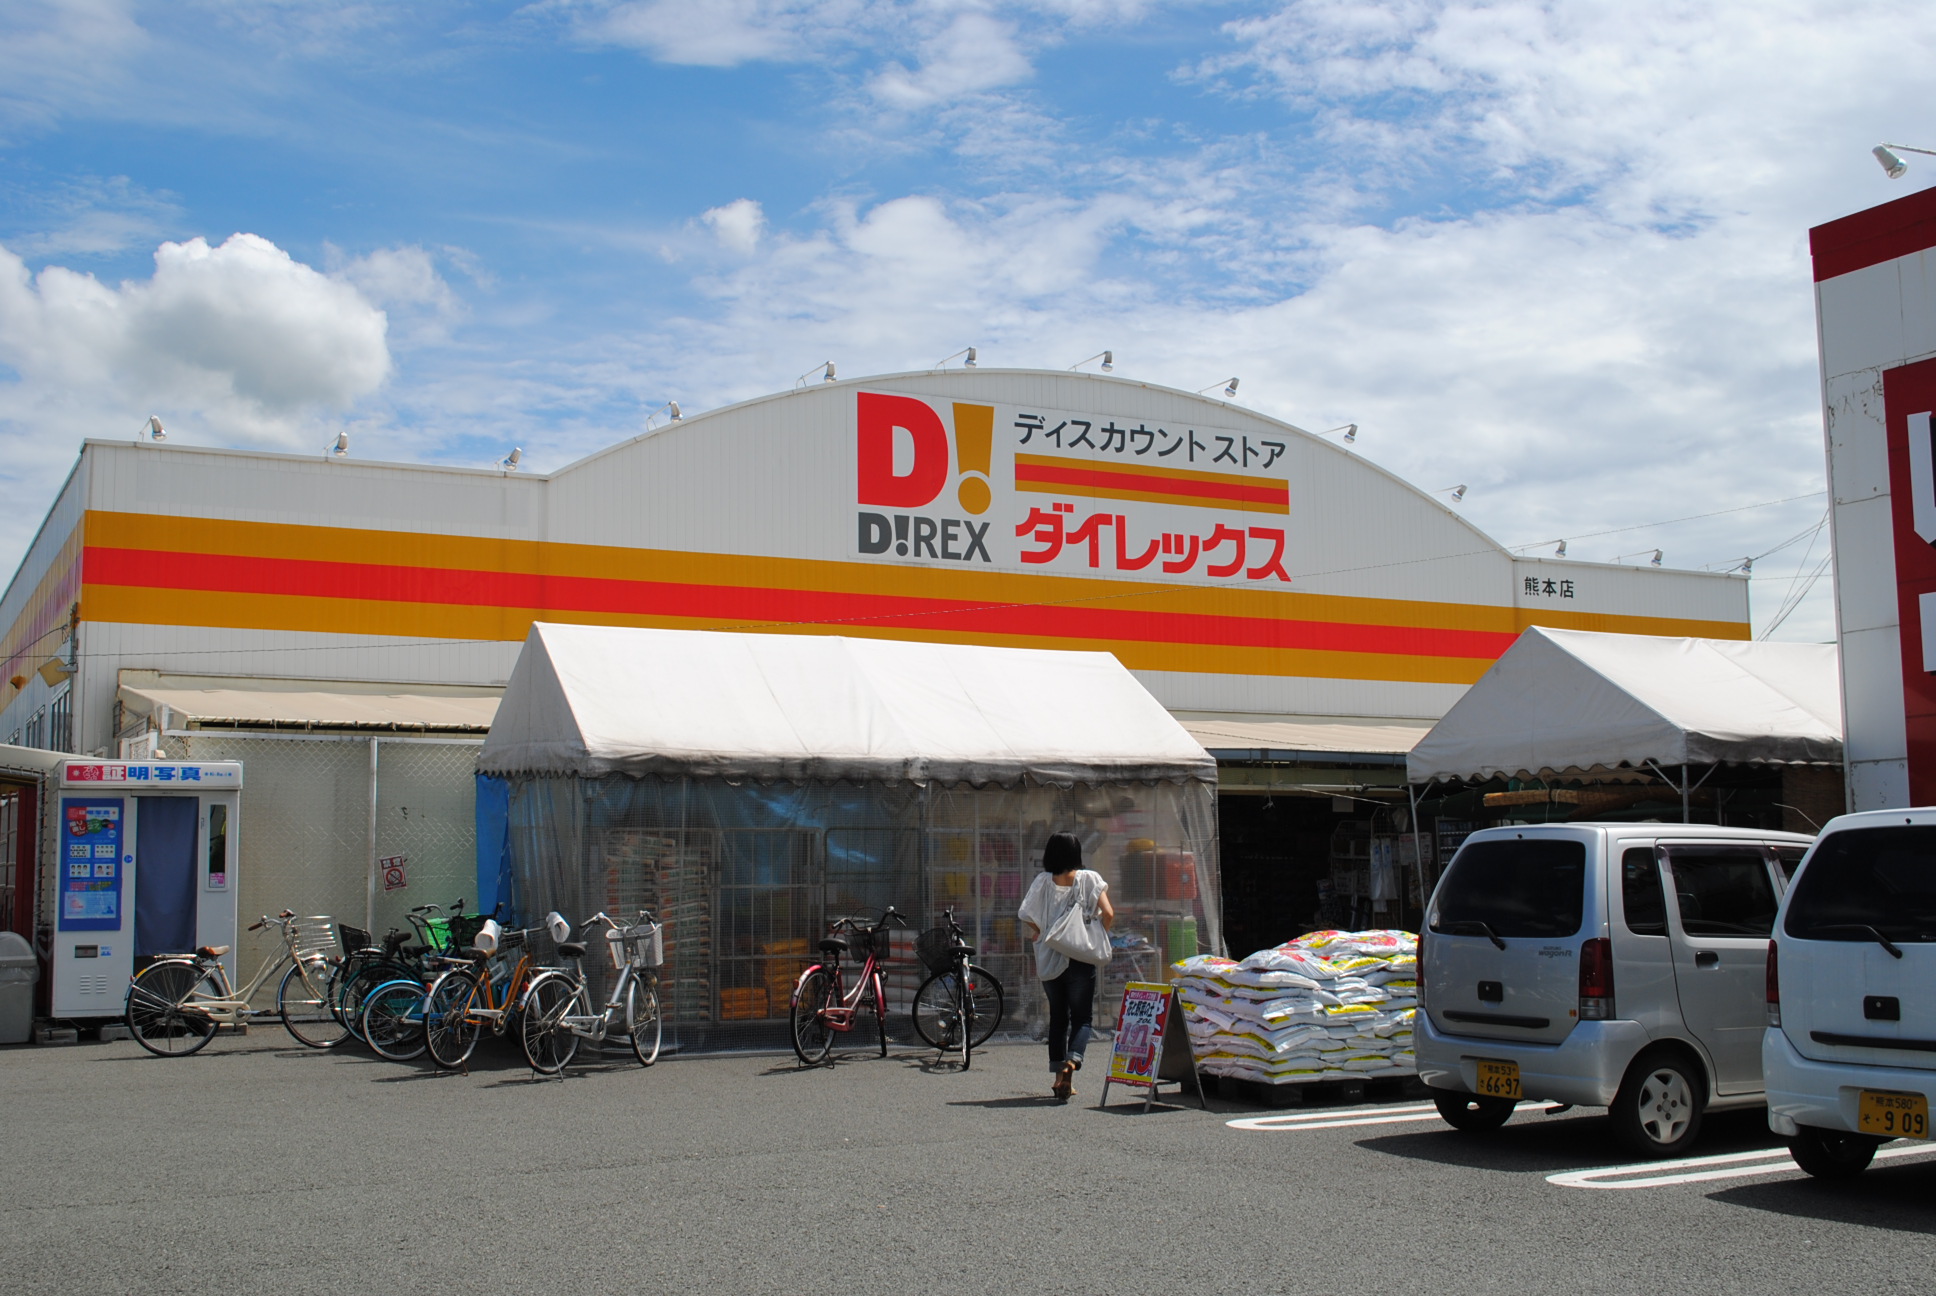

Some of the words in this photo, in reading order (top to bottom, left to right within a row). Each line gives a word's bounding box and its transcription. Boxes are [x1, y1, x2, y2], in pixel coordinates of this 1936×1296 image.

[858, 511, 992, 563] D!REX
[1015, 502, 1292, 583] ダイレックス
[1524, 576, 1574, 598] 熊本店
[102, 766, 201, 781] 証明写真
